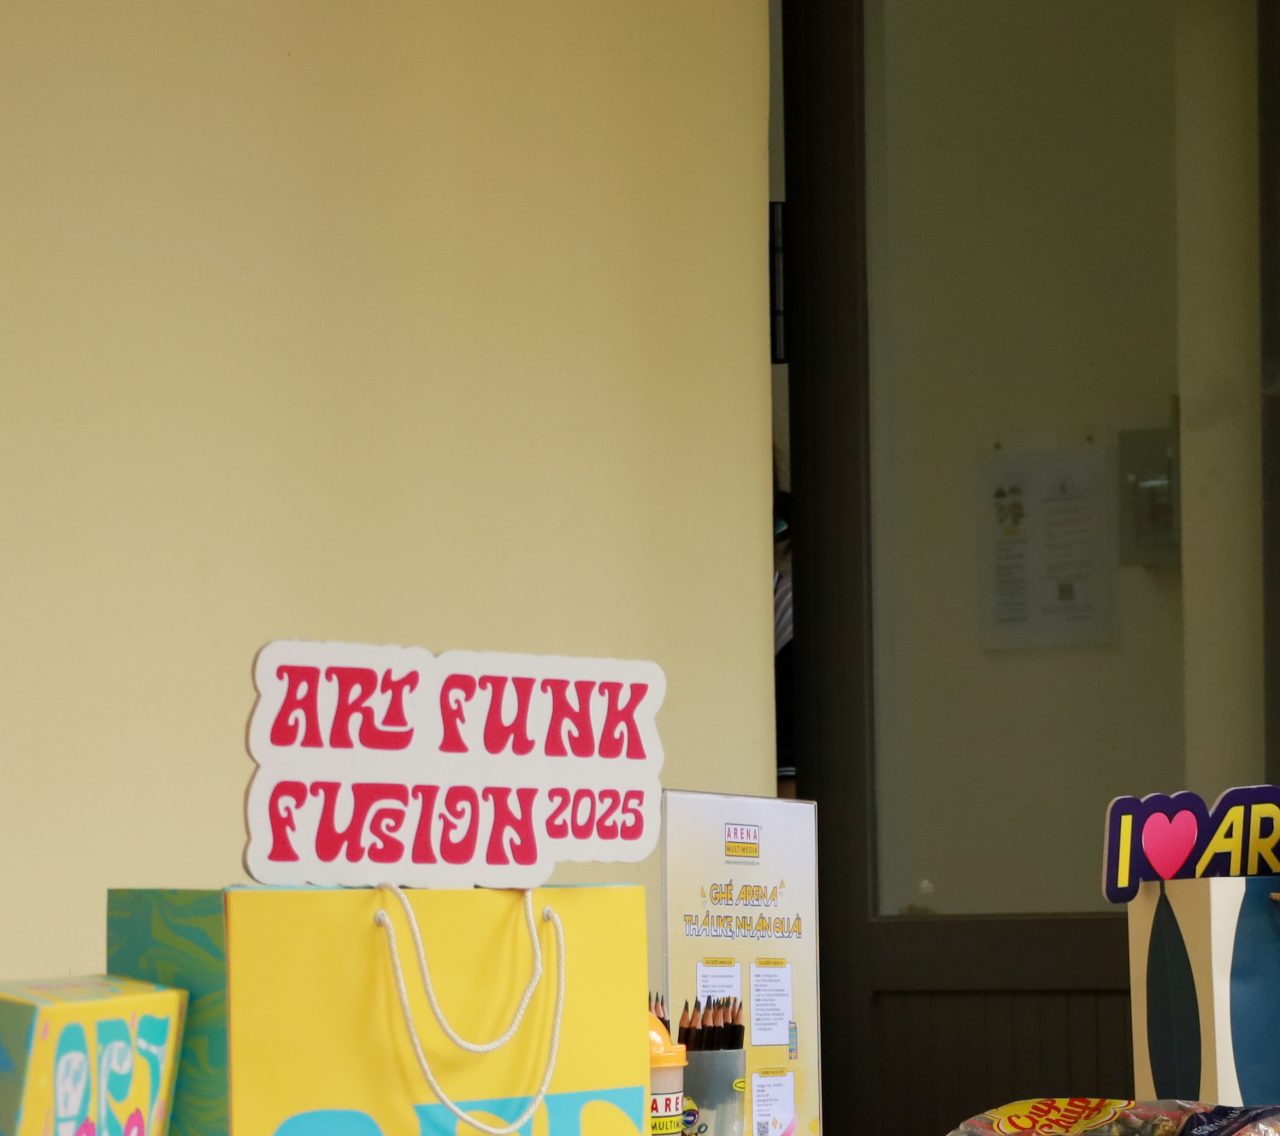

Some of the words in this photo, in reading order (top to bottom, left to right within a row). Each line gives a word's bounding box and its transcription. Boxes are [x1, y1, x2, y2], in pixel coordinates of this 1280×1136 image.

[270, 664, 419, 751] ART
[438, 673, 649, 760] FUNK
[267, 780, 539, 866] FUSION
[545, 787, 645, 841] 2025
[726, 826, 758, 842] ARENA
[1118, 814, 1133, 888] I
[735, 883, 779, 908] ARENA
